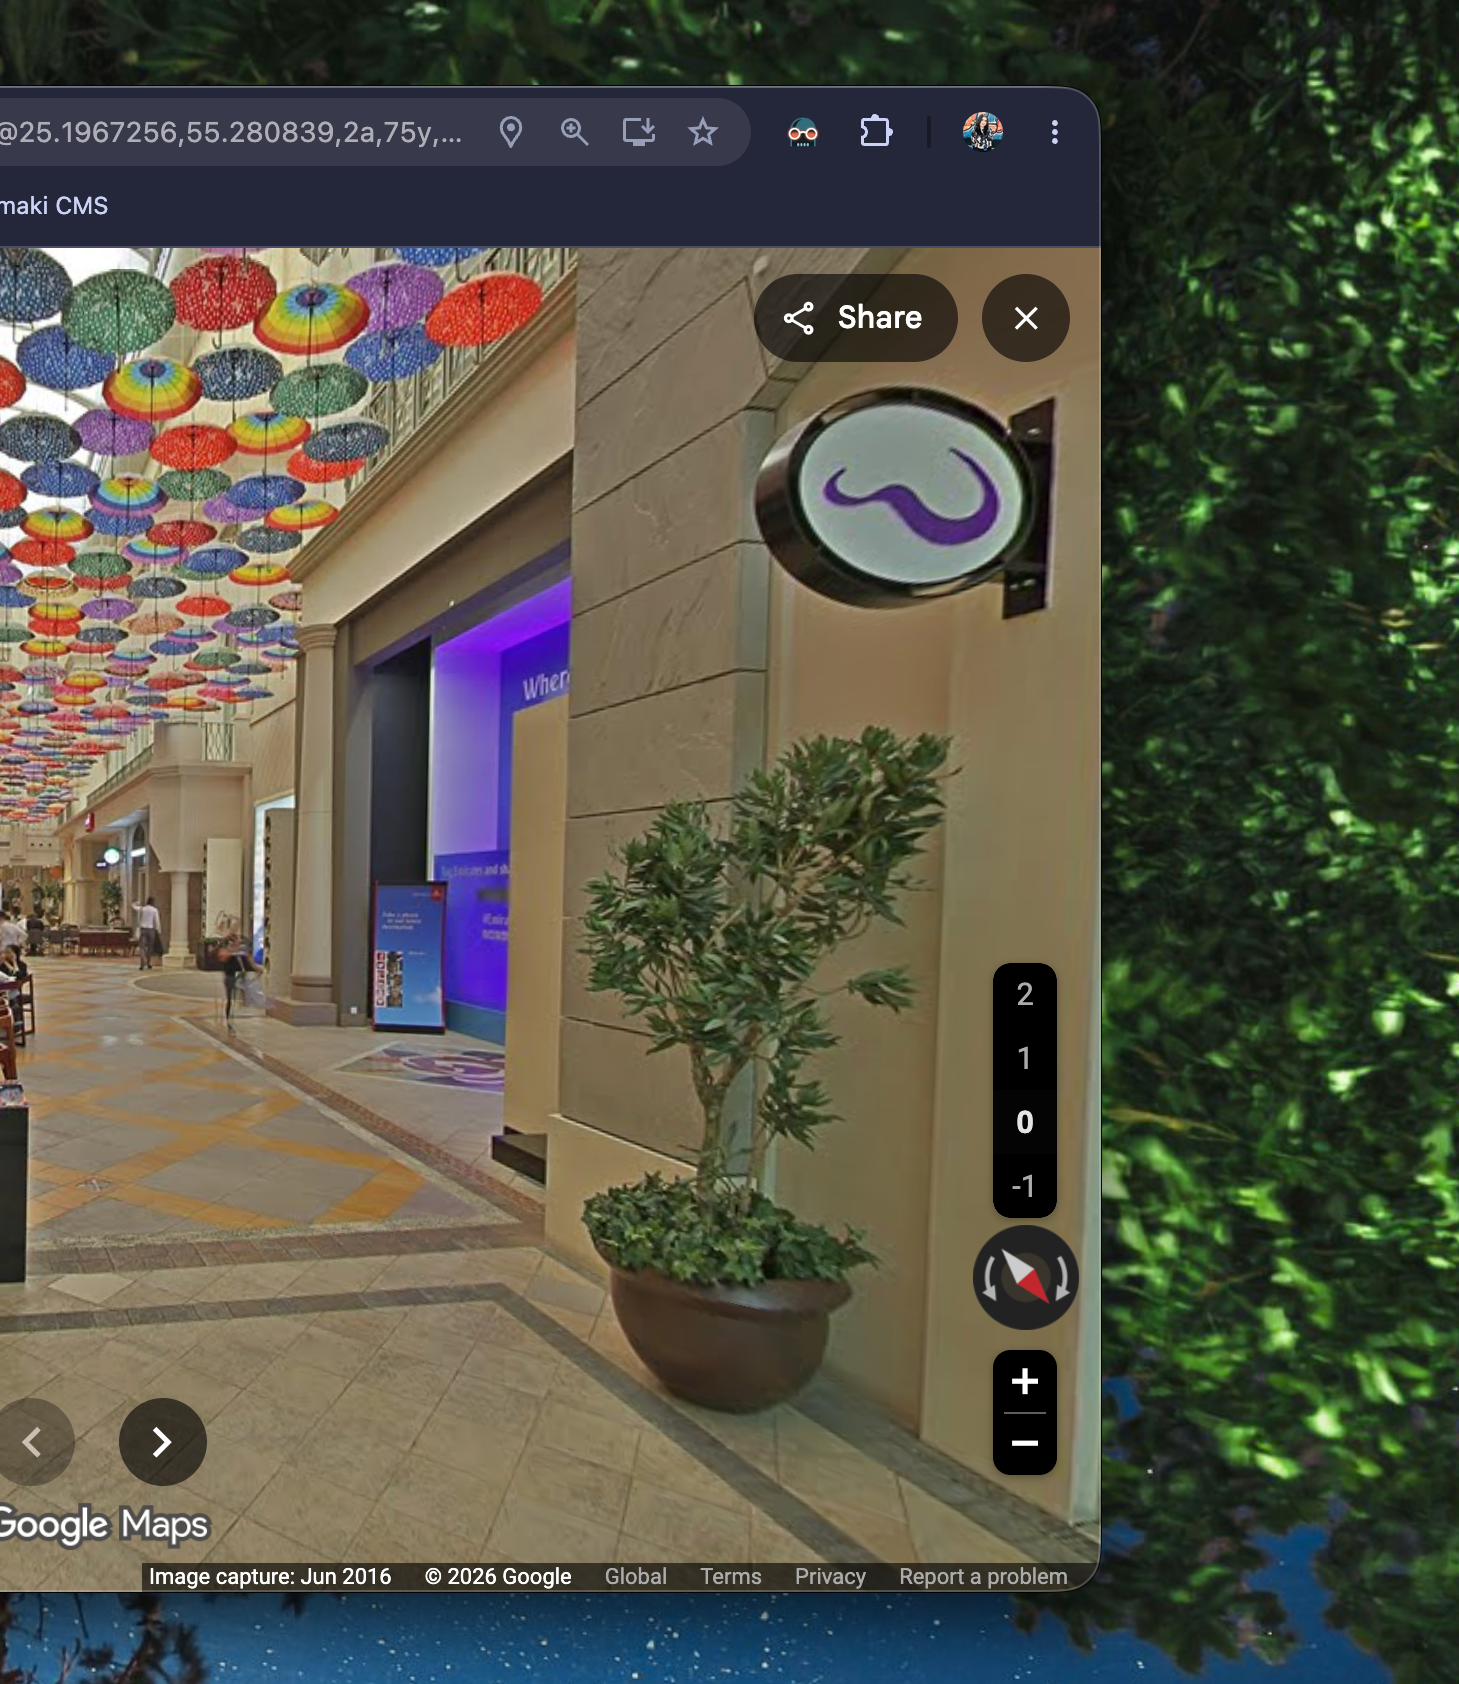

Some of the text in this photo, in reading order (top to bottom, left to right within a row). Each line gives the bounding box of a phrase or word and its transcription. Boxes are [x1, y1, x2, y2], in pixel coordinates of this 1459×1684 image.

[55, 195, 109, 215] CMS
[838, 303, 923, 330] Share
[1017, 981, 1034, 1006] 2
[1018, 1046, 1029, 1070] 1
[1016, 1109, 1034, 1135] 0
[1011, 1174, 1033, 1198] -1
[122, 1508, 208, 1545] Maps
[149, 1566, 392, 1589] Image capture: Jun 2016
[447, 1567, 497, 1585] 2026
[502, 1567, 572, 1590] Google
[604, 1567, 667, 1585] Global
[700, 1567, 762, 1585] Terms
[794, 1567, 867, 1590] Privacy
[899, 1567, 1068, 1590] Report a problem
